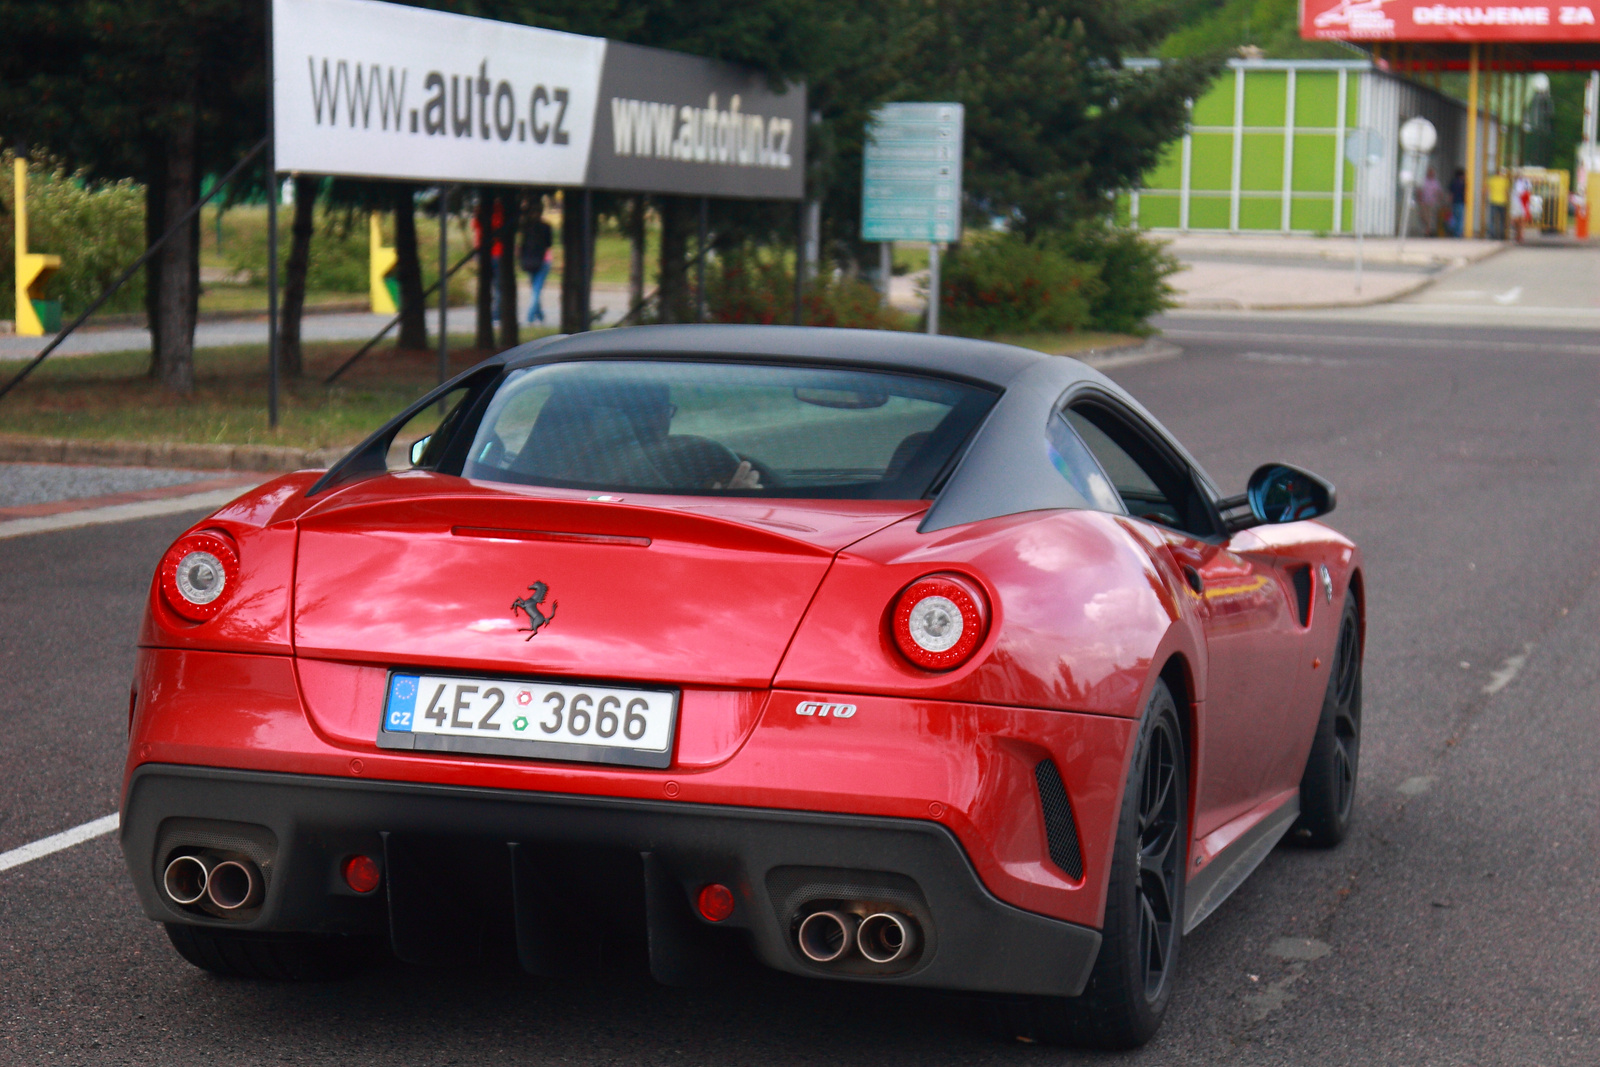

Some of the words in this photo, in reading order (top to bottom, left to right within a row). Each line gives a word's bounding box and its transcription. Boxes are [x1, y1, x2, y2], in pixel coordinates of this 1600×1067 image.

[1412, 4, 1549, 25] DĚKUJEME
[1558, 6, 1595, 25] ZA
[308, 56, 570, 146] www.auto.cz
[611, 92, 792, 169] www.autofun.cz
[390, 711, 410, 726] CZ
[424, 683, 505, 731] 4E2
[539, 691, 649, 741] 3666
[795, 700, 857, 718] GTO
